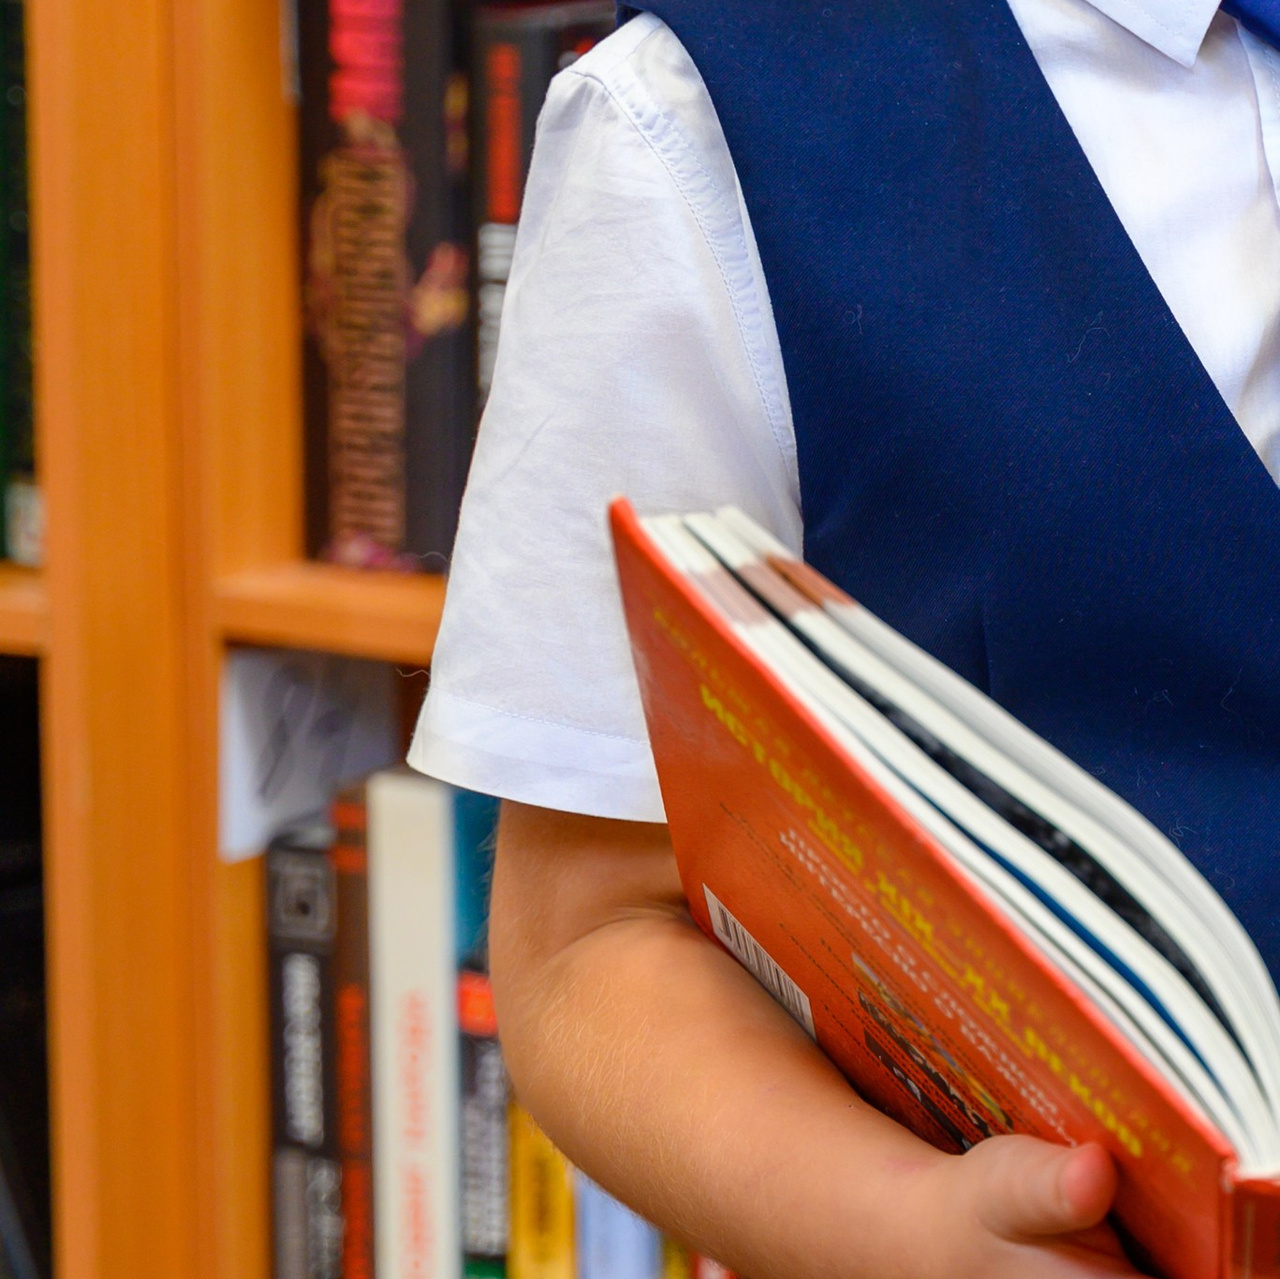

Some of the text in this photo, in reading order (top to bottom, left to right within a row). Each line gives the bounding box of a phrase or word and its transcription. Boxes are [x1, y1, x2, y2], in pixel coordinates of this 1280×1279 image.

[701, 681, 864, 870] ИСТОРИЯ
[1023, 1024, 1144, 1162] ВЕКОВ
[780, 830, 927, 995] ИНТЕРЕСНО
[788, 826, 890, 943] ПРОСТО
